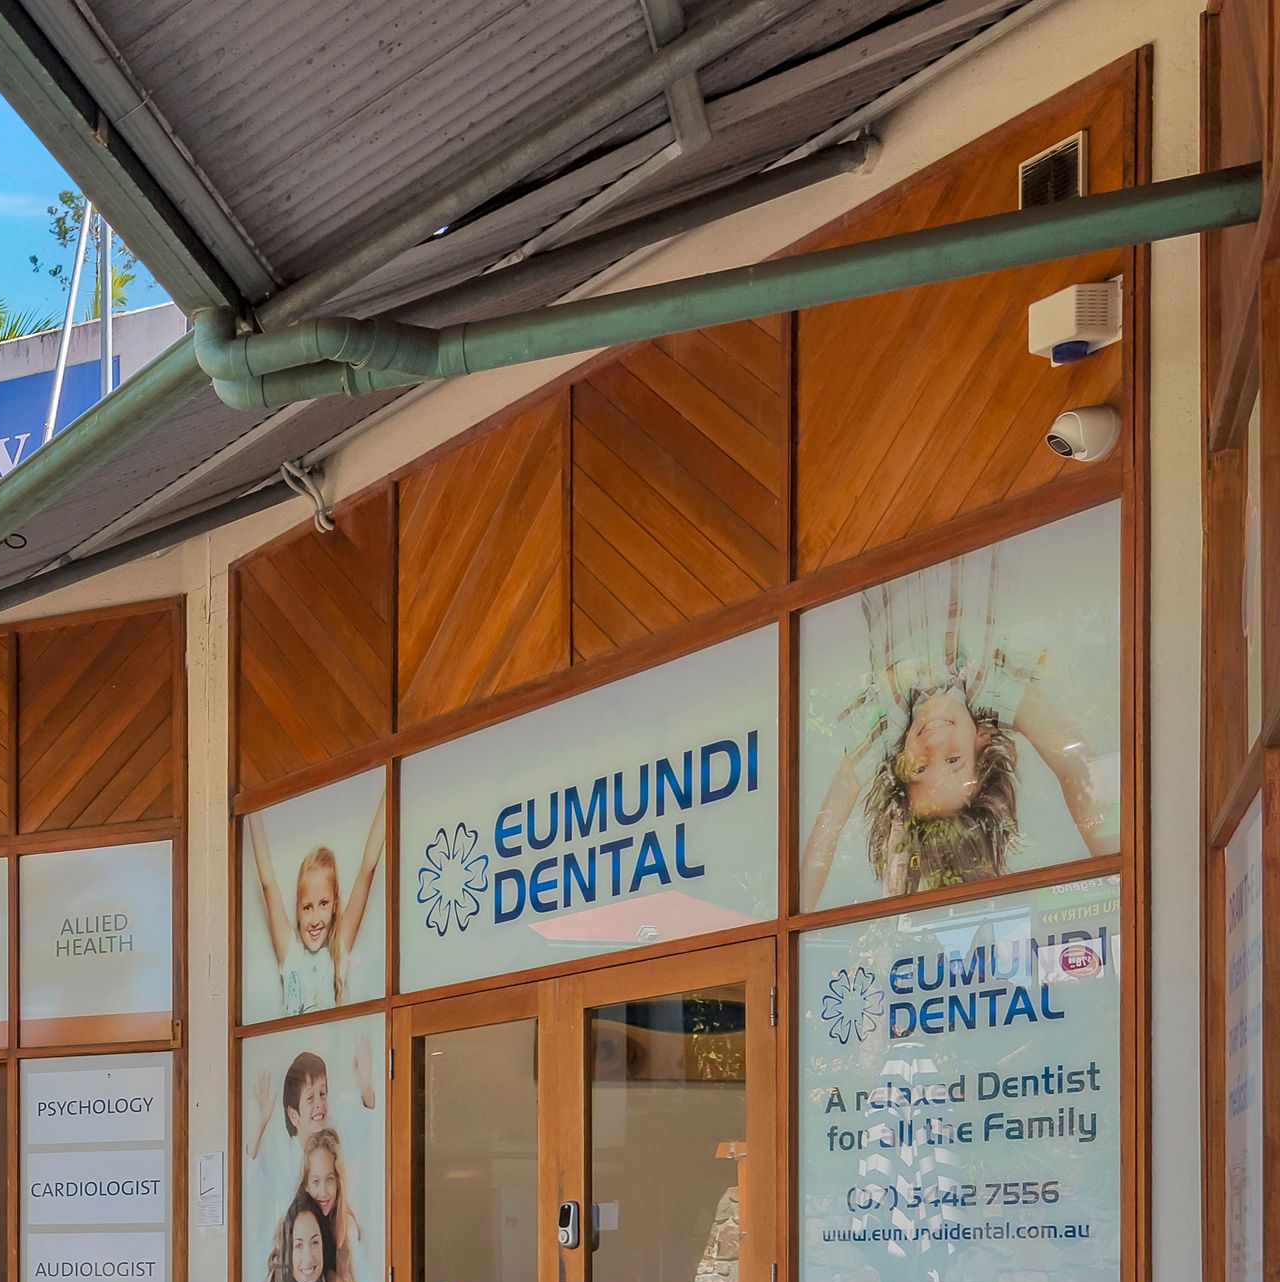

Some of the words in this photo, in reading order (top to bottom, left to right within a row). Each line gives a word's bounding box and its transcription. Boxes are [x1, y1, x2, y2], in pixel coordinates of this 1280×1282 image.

[493, 729, 760, 859] EUMUNDI
[493, 822, 706, 925] DENTAL
[60, 913, 129, 936] ALLIED
[55, 934, 134, 957] HEALTH
[889, 926, 1108, 996] EUMUNI
[889, 982, 1065, 1040] DENTAL
[824, 1087, 847, 1114] A
[855, 1074, 966, 1111] relaxed
[977, 1061, 1101, 1101] Dentist
[37, 1096, 154, 1117] PSYCHOLOGY
[827, 1125, 870, 1151] for
[878, 1119, 914, 1149] all
[923, 1116, 973, 1146] the
[983, 1107, 1098, 1143] Family
[30, 1179, 161, 1198] CARDIOLOGIST
[984, 1180, 1060, 1206] 7556
[35, 1261, 156, 1277] AUDIOLOGIST
